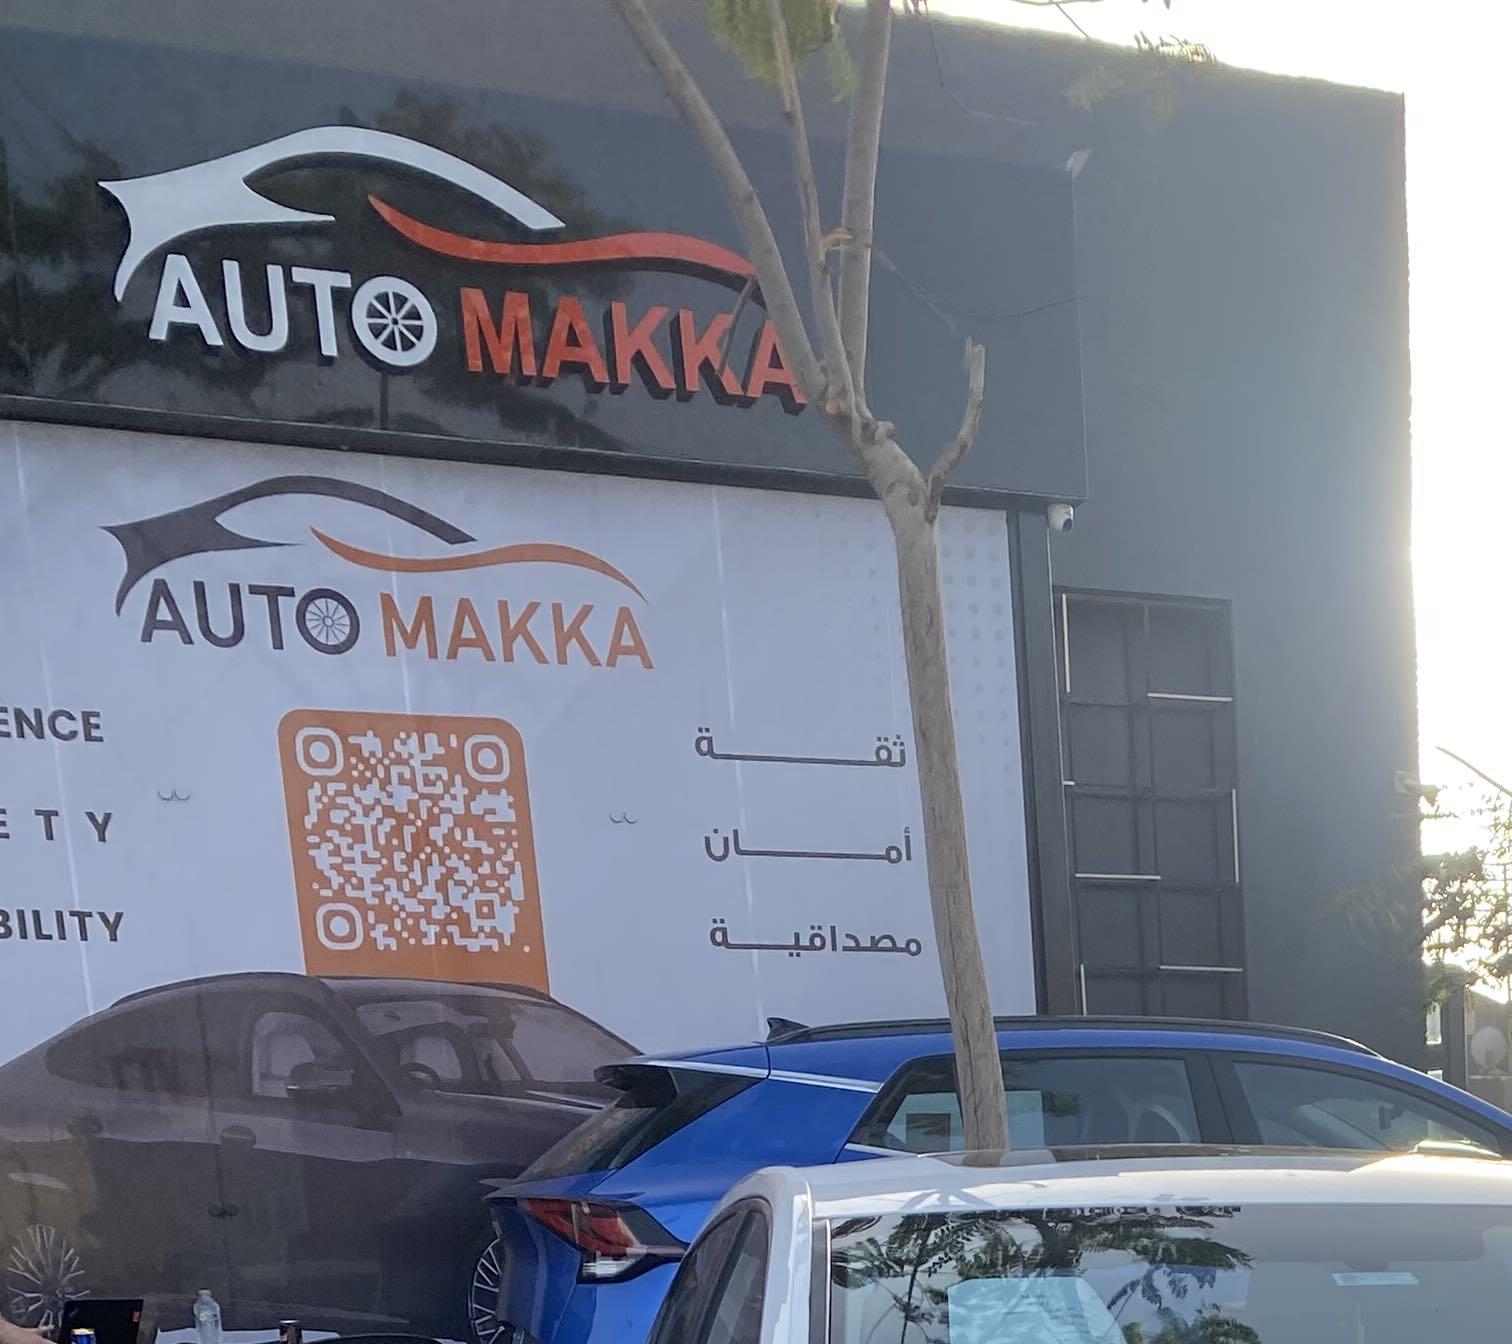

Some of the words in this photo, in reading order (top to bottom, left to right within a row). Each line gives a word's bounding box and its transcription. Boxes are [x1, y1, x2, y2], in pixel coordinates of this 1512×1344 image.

[150, 252, 438, 368] AUTO
[459, 287, 807, 410] MAKKA
[141, 578, 360, 656] AUTO
[380, 592, 654, 670] MAKKA
[710, 918, 922, 958] مصداقية
